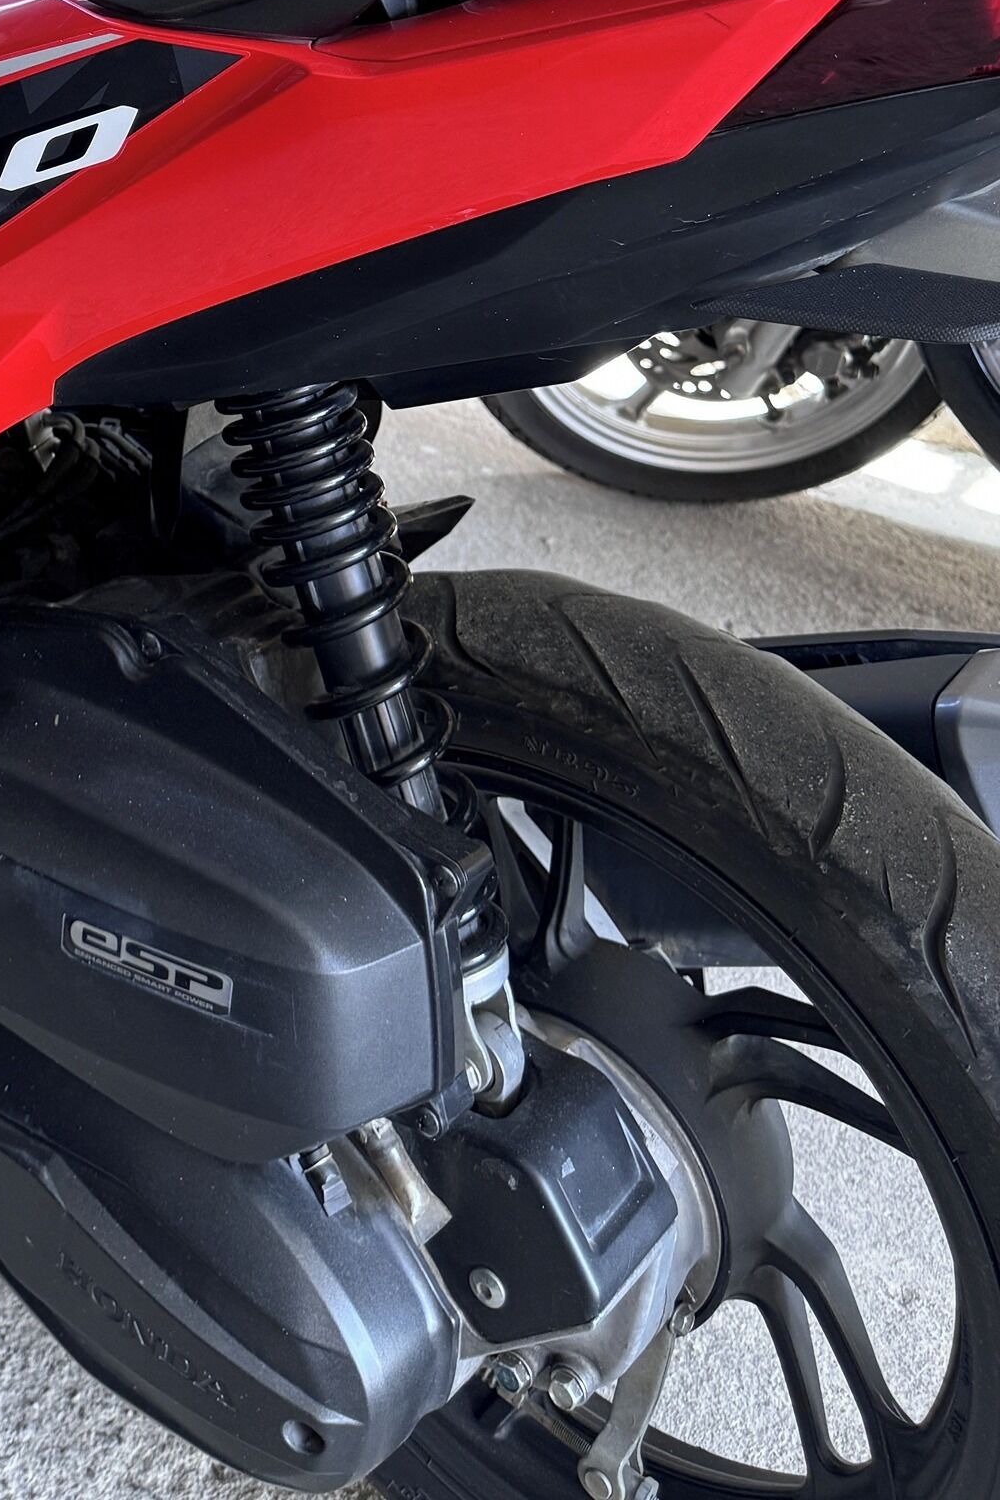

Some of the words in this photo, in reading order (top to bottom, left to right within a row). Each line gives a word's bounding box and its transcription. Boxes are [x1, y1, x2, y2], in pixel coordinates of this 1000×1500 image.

[74, 948, 132, 978] ENHANCED
[133, 973, 172, 993] SMART
[174, 990, 214, 1011] POWER
[55, 1252, 236, 1413] HONDA
